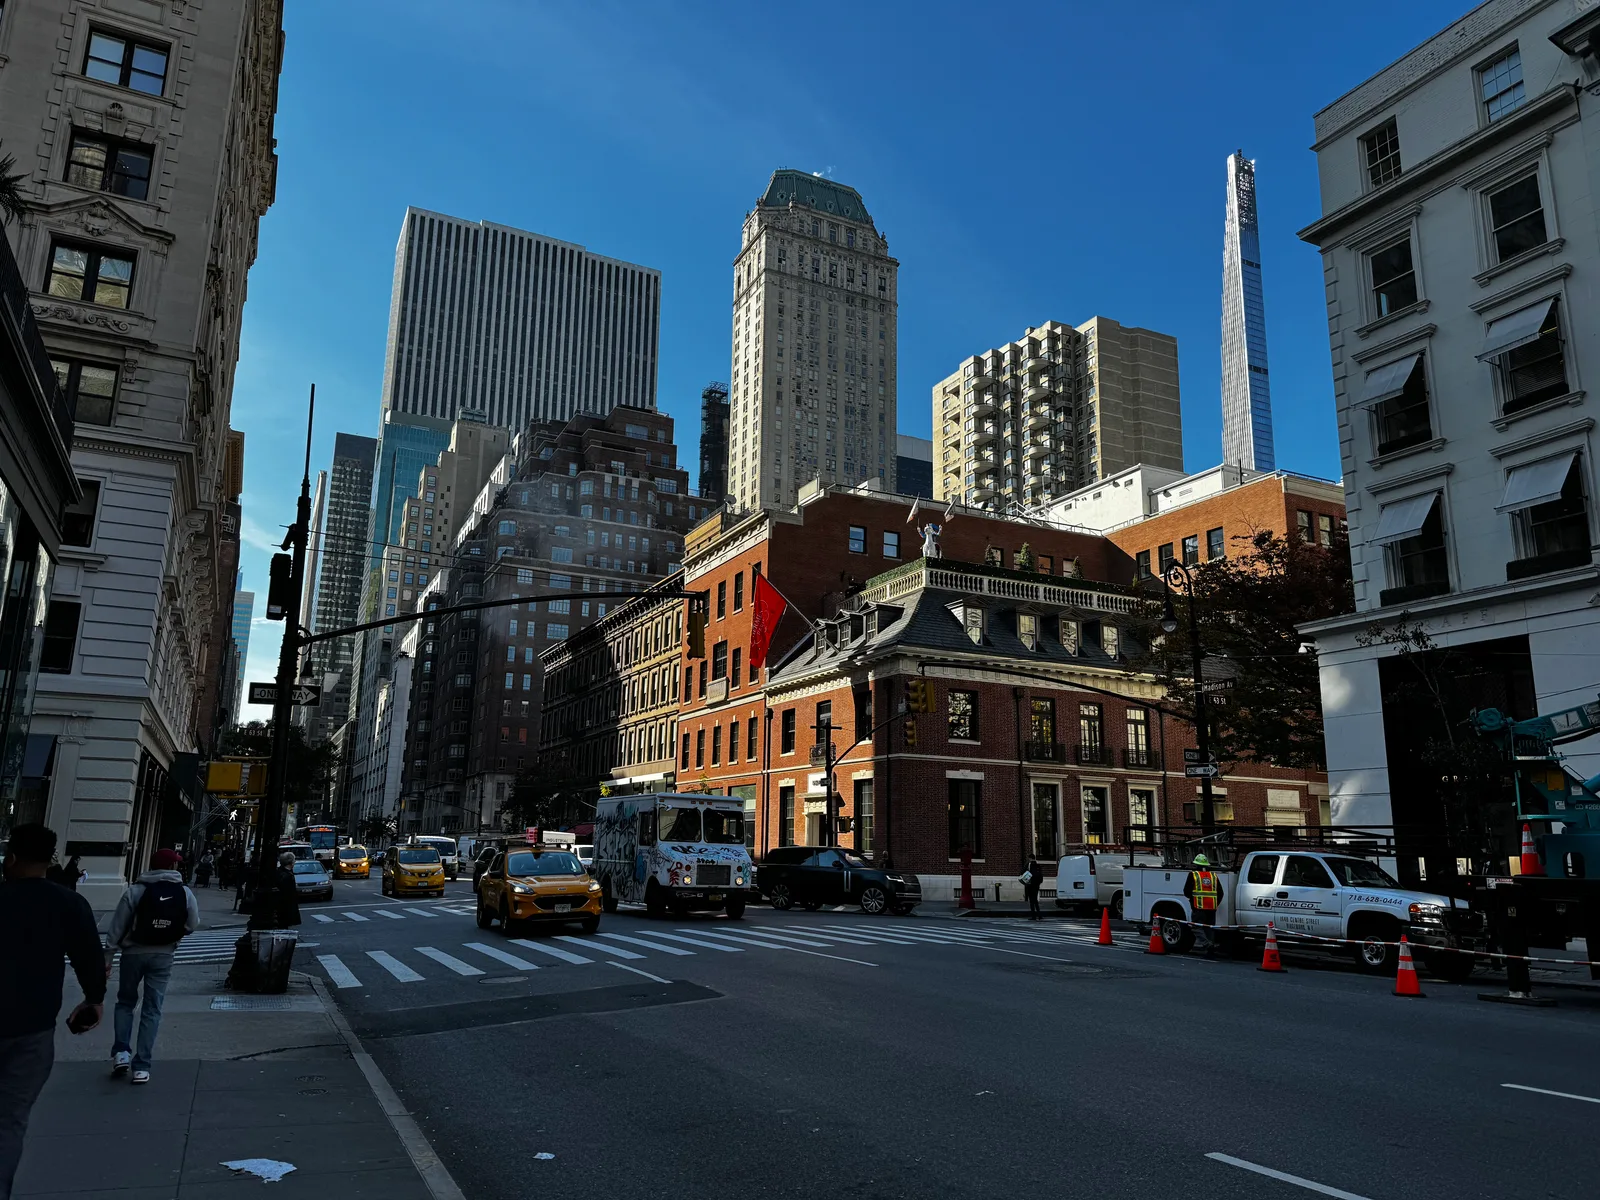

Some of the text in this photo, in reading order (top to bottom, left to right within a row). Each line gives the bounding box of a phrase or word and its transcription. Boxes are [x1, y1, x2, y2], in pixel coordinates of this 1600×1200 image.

[1203, 682, 1225, 691] Madison
[1257, 899, 1272, 908] LS
[1348, 894, 1403, 905] 718-628-0444
